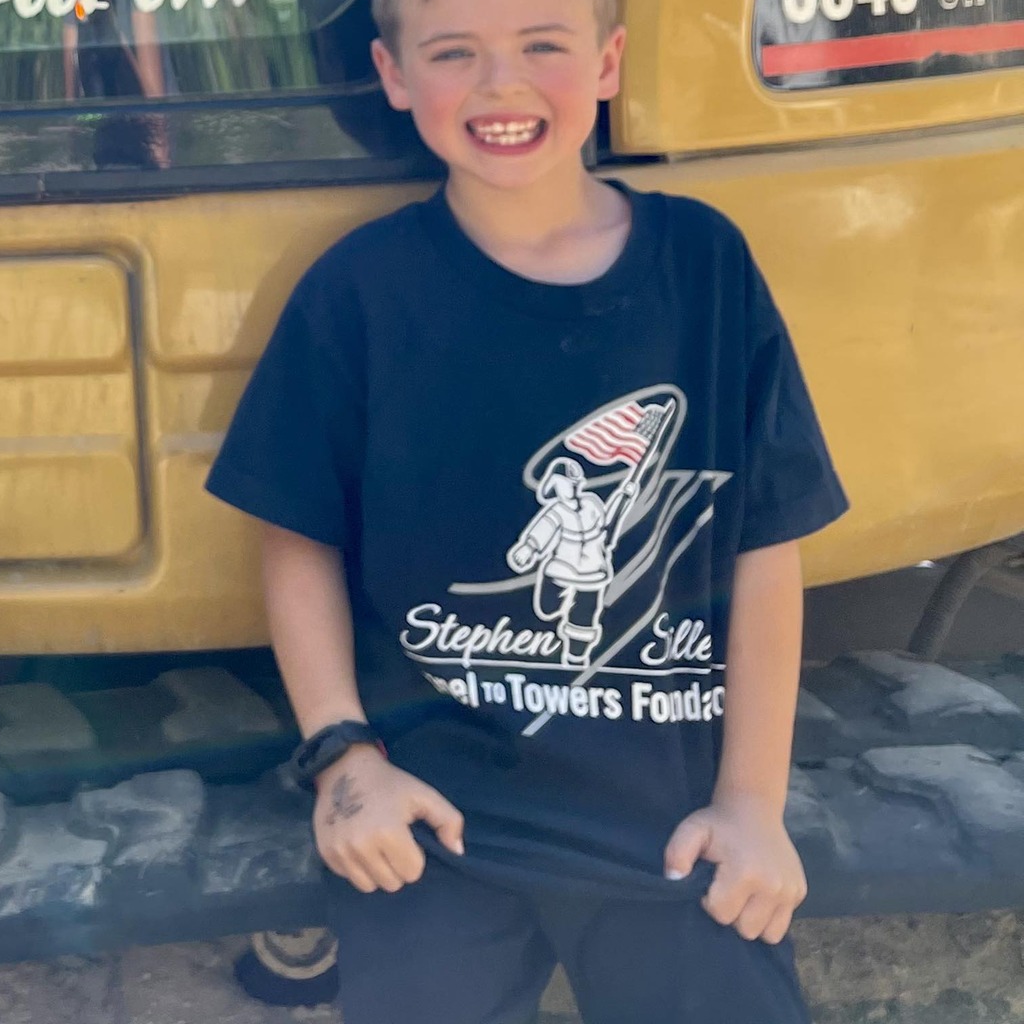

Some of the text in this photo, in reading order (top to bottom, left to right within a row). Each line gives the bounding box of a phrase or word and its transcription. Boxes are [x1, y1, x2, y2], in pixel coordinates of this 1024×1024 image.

[399, 603, 562, 669] Stephen
[480, 681, 507, 704] TO
[504, 673, 623, 720] Towers
